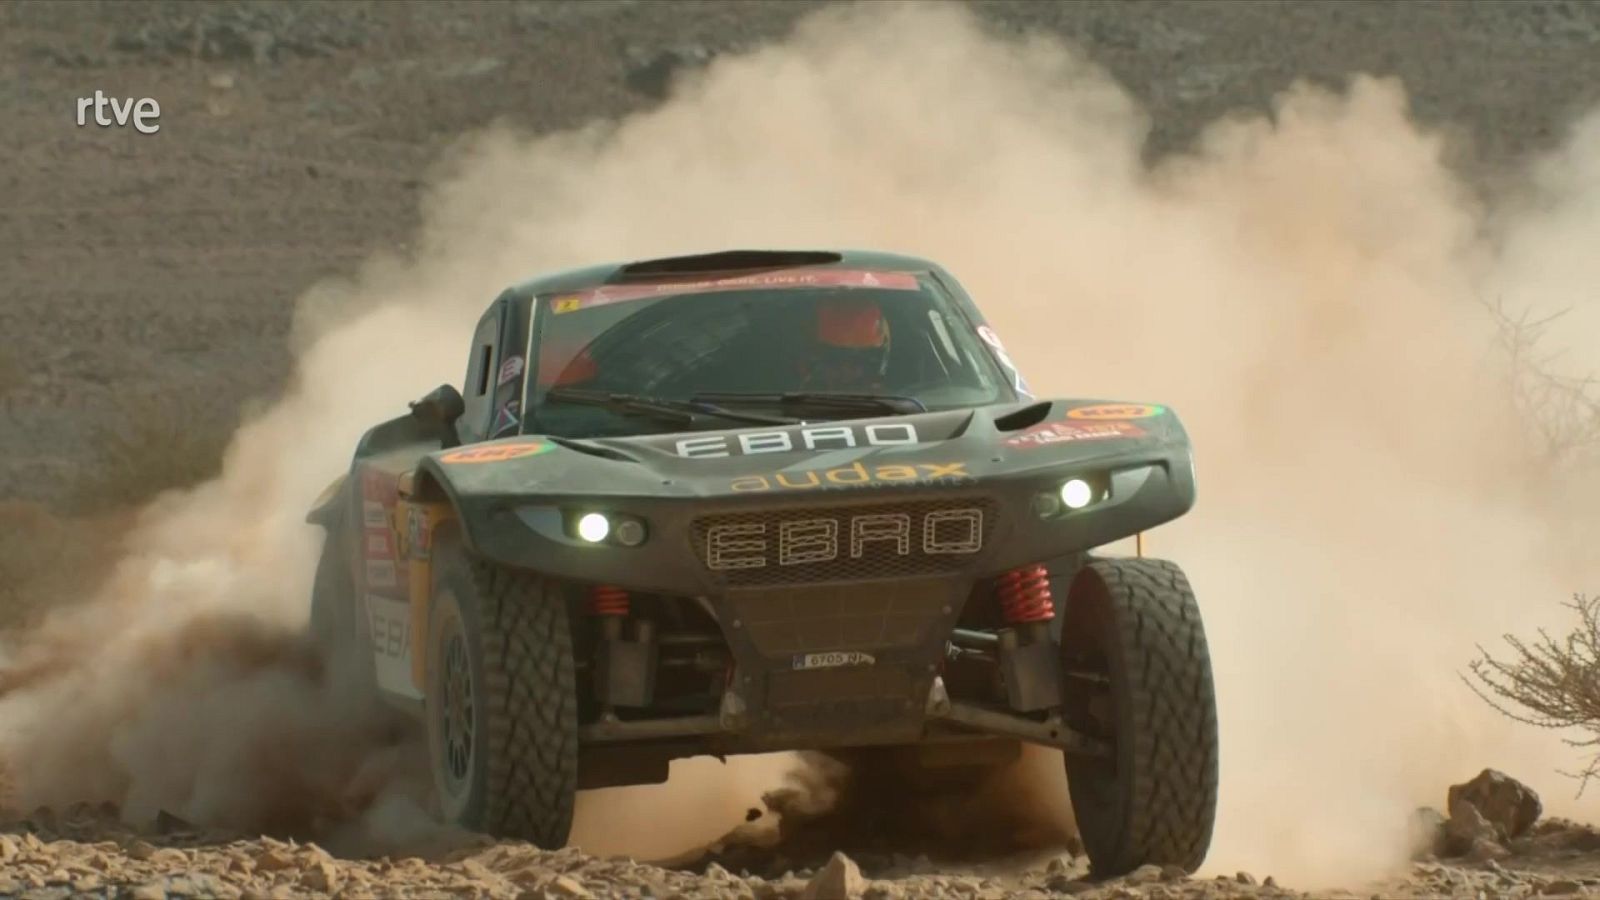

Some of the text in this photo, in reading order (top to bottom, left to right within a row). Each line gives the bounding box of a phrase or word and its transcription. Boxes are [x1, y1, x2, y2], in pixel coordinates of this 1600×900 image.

[675, 423, 919, 459] EBRO
[731, 461, 970, 493] audax
[707, 508, 983, 570] EBRO
